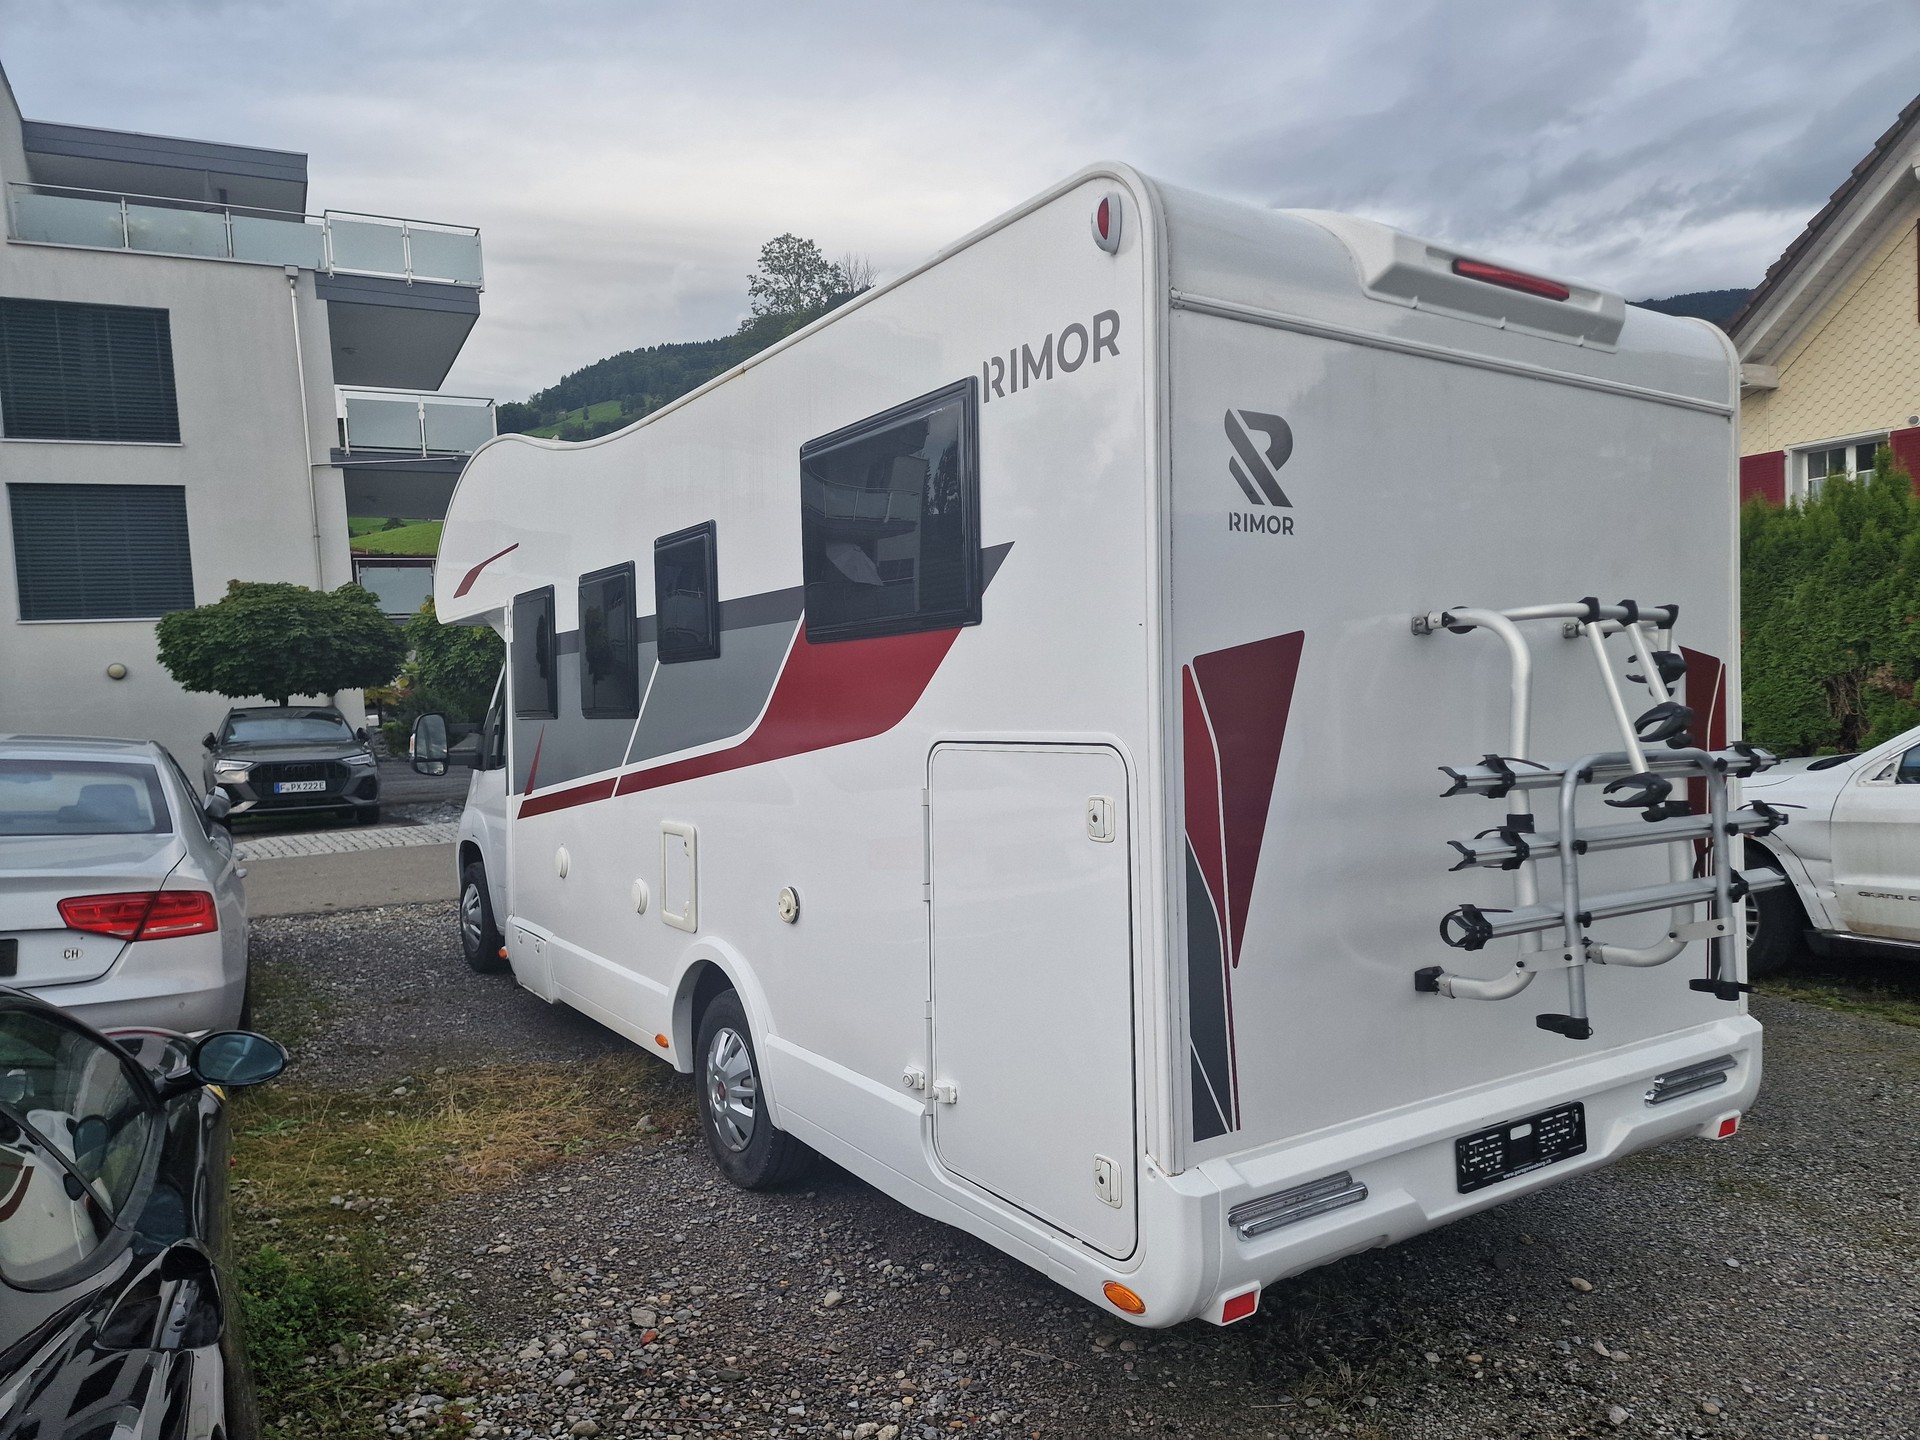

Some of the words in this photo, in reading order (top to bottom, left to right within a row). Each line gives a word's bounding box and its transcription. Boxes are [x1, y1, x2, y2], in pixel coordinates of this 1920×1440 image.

[983, 309, 1120, 404] RIMOR
[1228, 511, 1294, 536] RIMOR
[63, 949, 79, 960] CH
